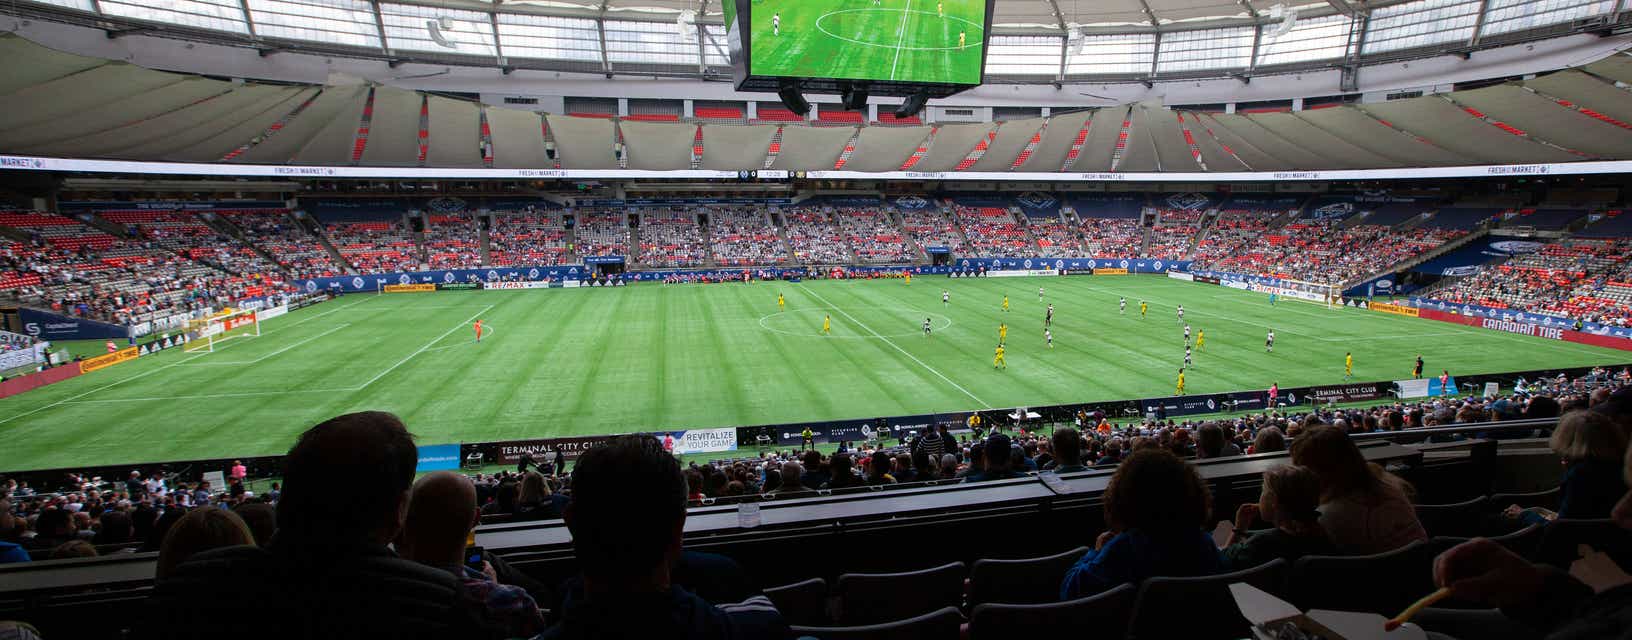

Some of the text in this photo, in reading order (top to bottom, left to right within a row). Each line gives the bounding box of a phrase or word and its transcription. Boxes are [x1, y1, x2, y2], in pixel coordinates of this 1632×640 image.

[0, 158, 31, 168] MARKET
[1512, 165, 1536, 174] MARKET
[492, 281, 524, 289] RE/MAX
[1482, 318, 1564, 340] CANADIAN TIRE
[686, 431, 734, 441] REVITALIZE
[687, 438, 735, 449] YOUR GAME
[502, 444, 553, 455] TERMINAL
